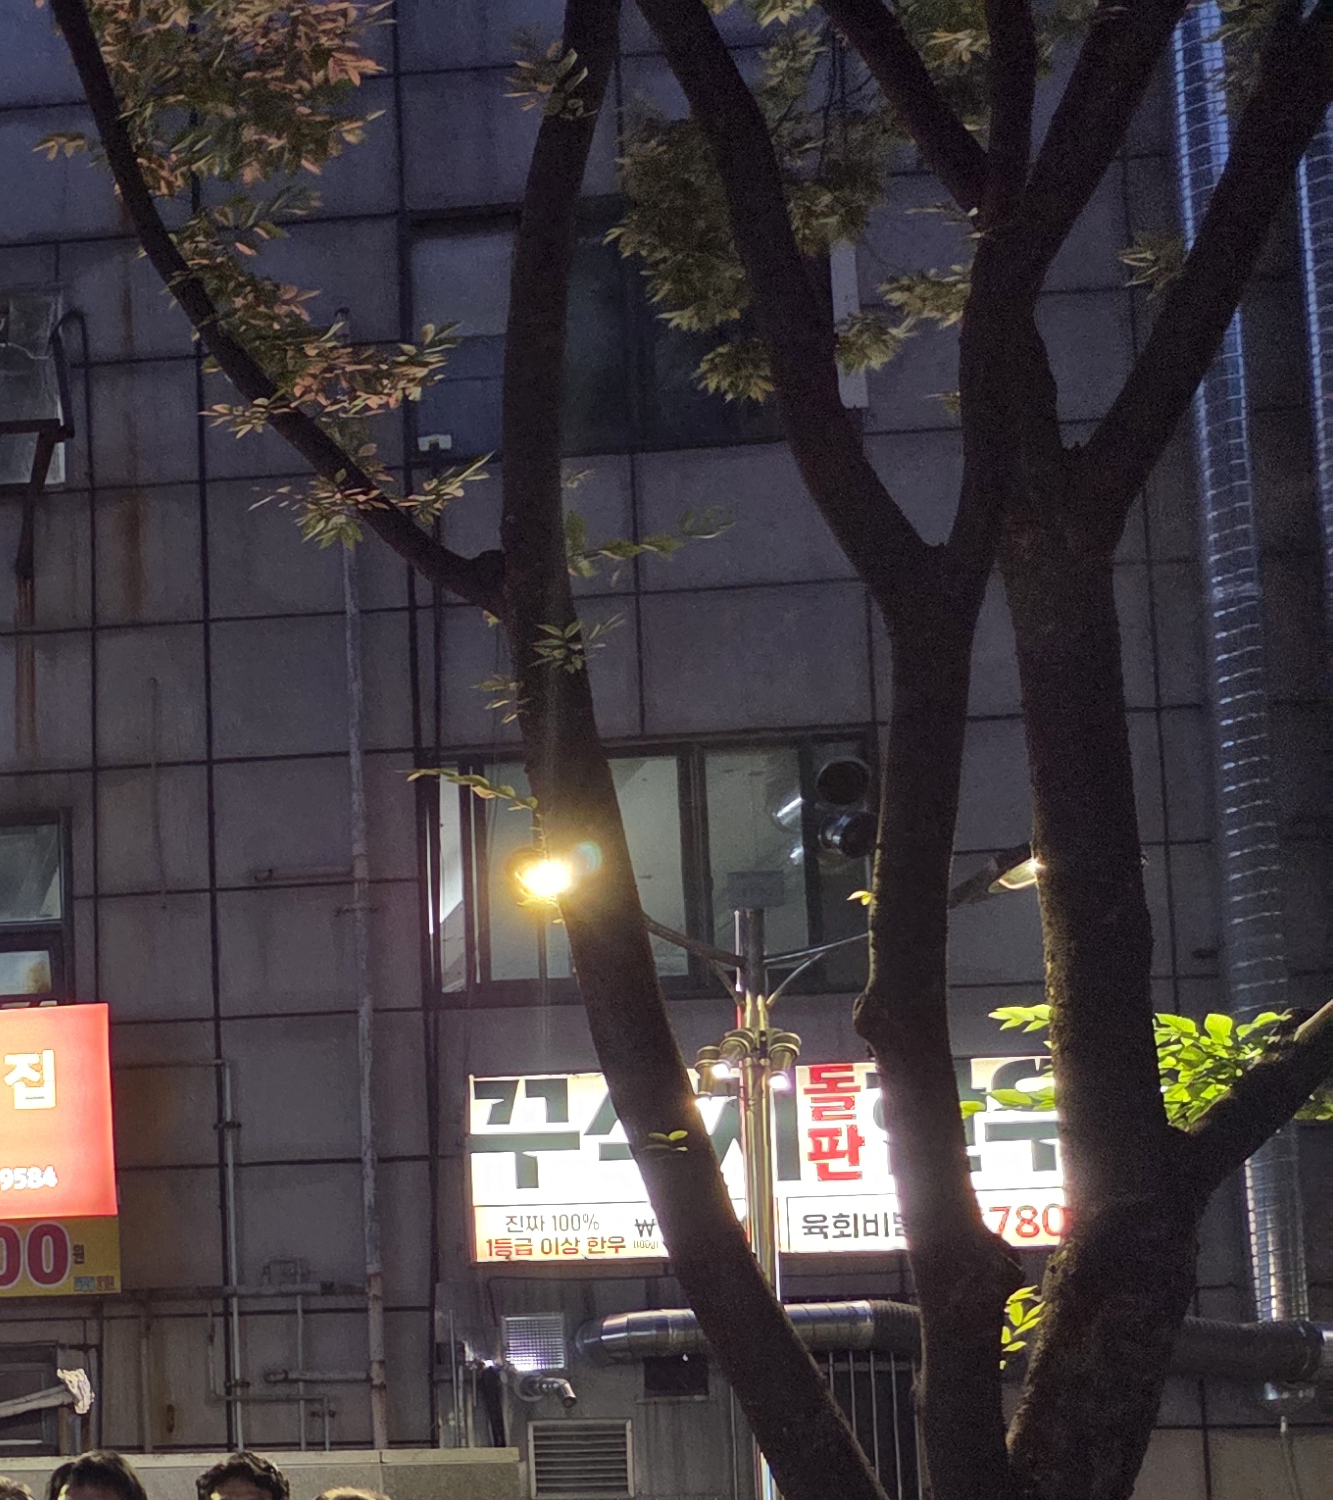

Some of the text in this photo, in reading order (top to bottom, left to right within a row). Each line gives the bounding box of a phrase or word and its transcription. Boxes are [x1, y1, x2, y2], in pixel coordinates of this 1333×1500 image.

[803, 1064, 866, 1181] 돌판
[505, 1213, 600, 1234] 진짜 100%
[486, 1236, 627, 1258] 1등급 이상 한우
